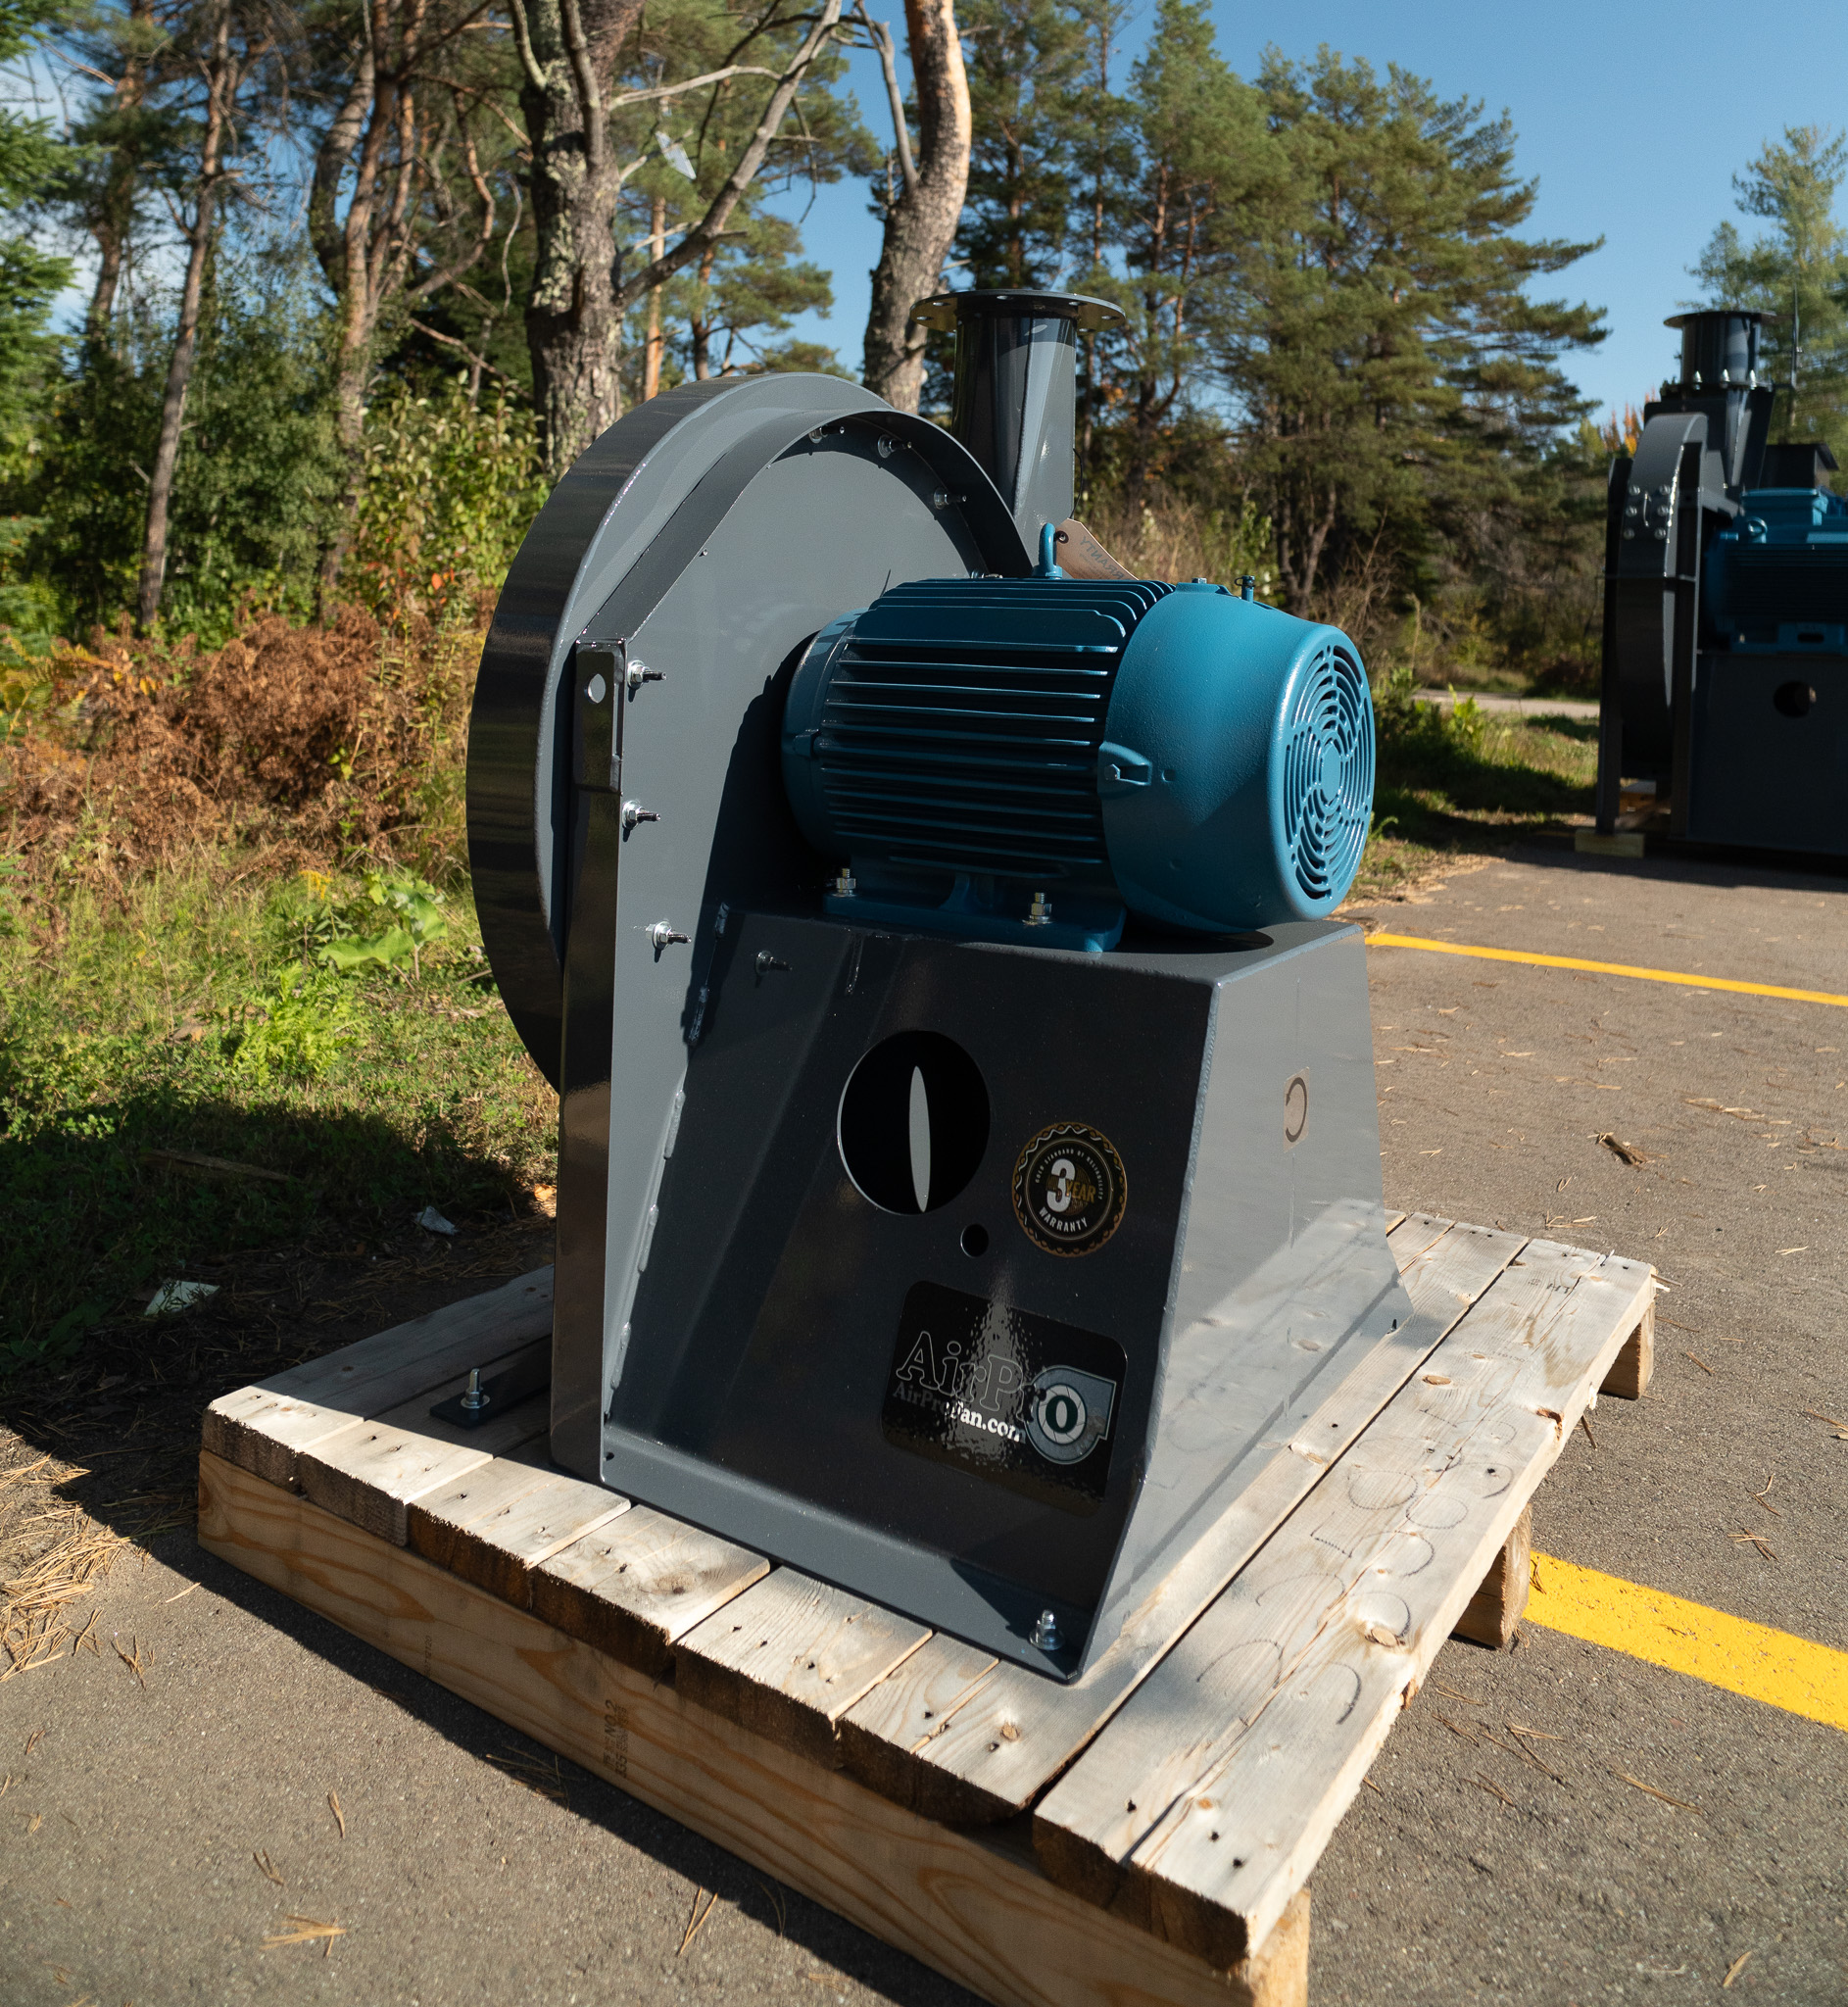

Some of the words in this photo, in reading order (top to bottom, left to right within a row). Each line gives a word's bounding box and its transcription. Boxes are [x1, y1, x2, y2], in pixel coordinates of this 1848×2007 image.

[1046, 1158, 1076, 1213] 3
[1065, 1179, 1096, 1203] YEAR
[1039, 1206, 1087, 1232] WARRANTY
